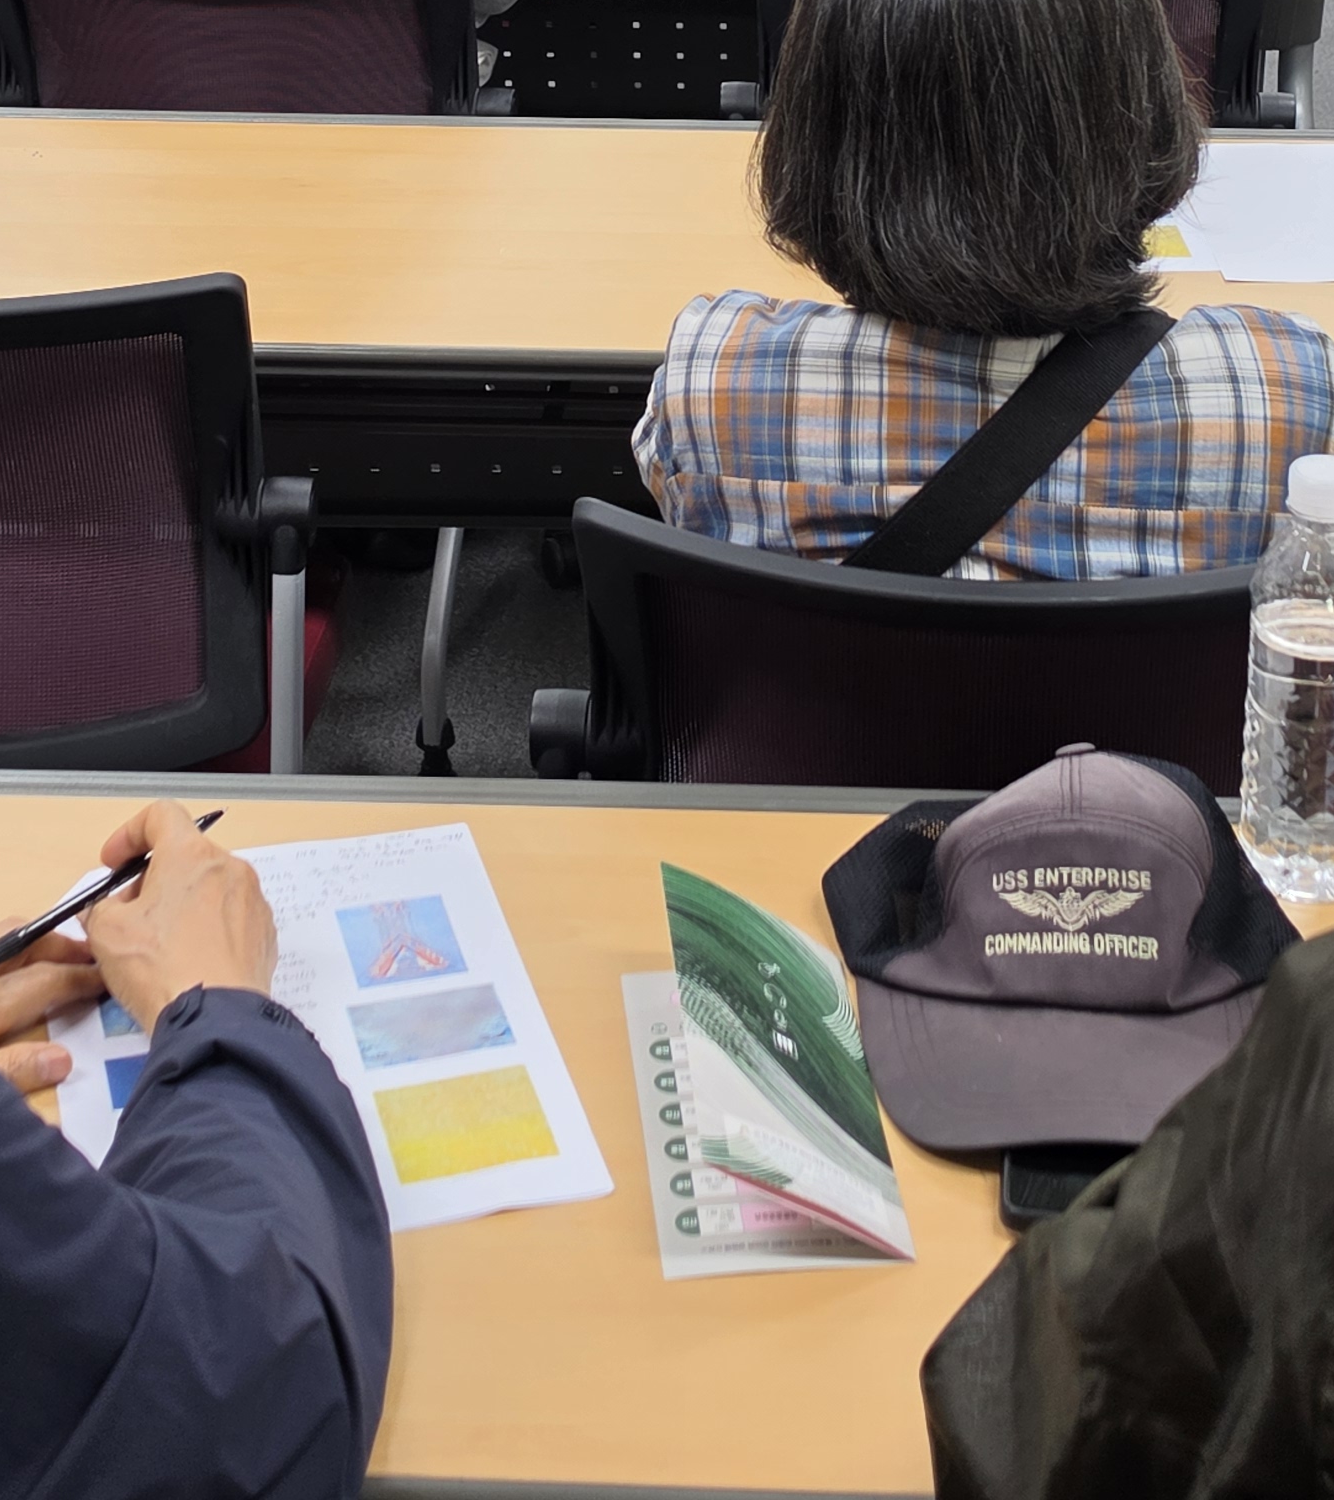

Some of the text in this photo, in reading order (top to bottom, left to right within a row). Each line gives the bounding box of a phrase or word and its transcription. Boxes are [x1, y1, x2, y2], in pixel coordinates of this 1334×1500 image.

[992, 866, 1152, 892] USS ENTERPRISE
[984, 931, 1160, 961] COMMANDING OFFICER
